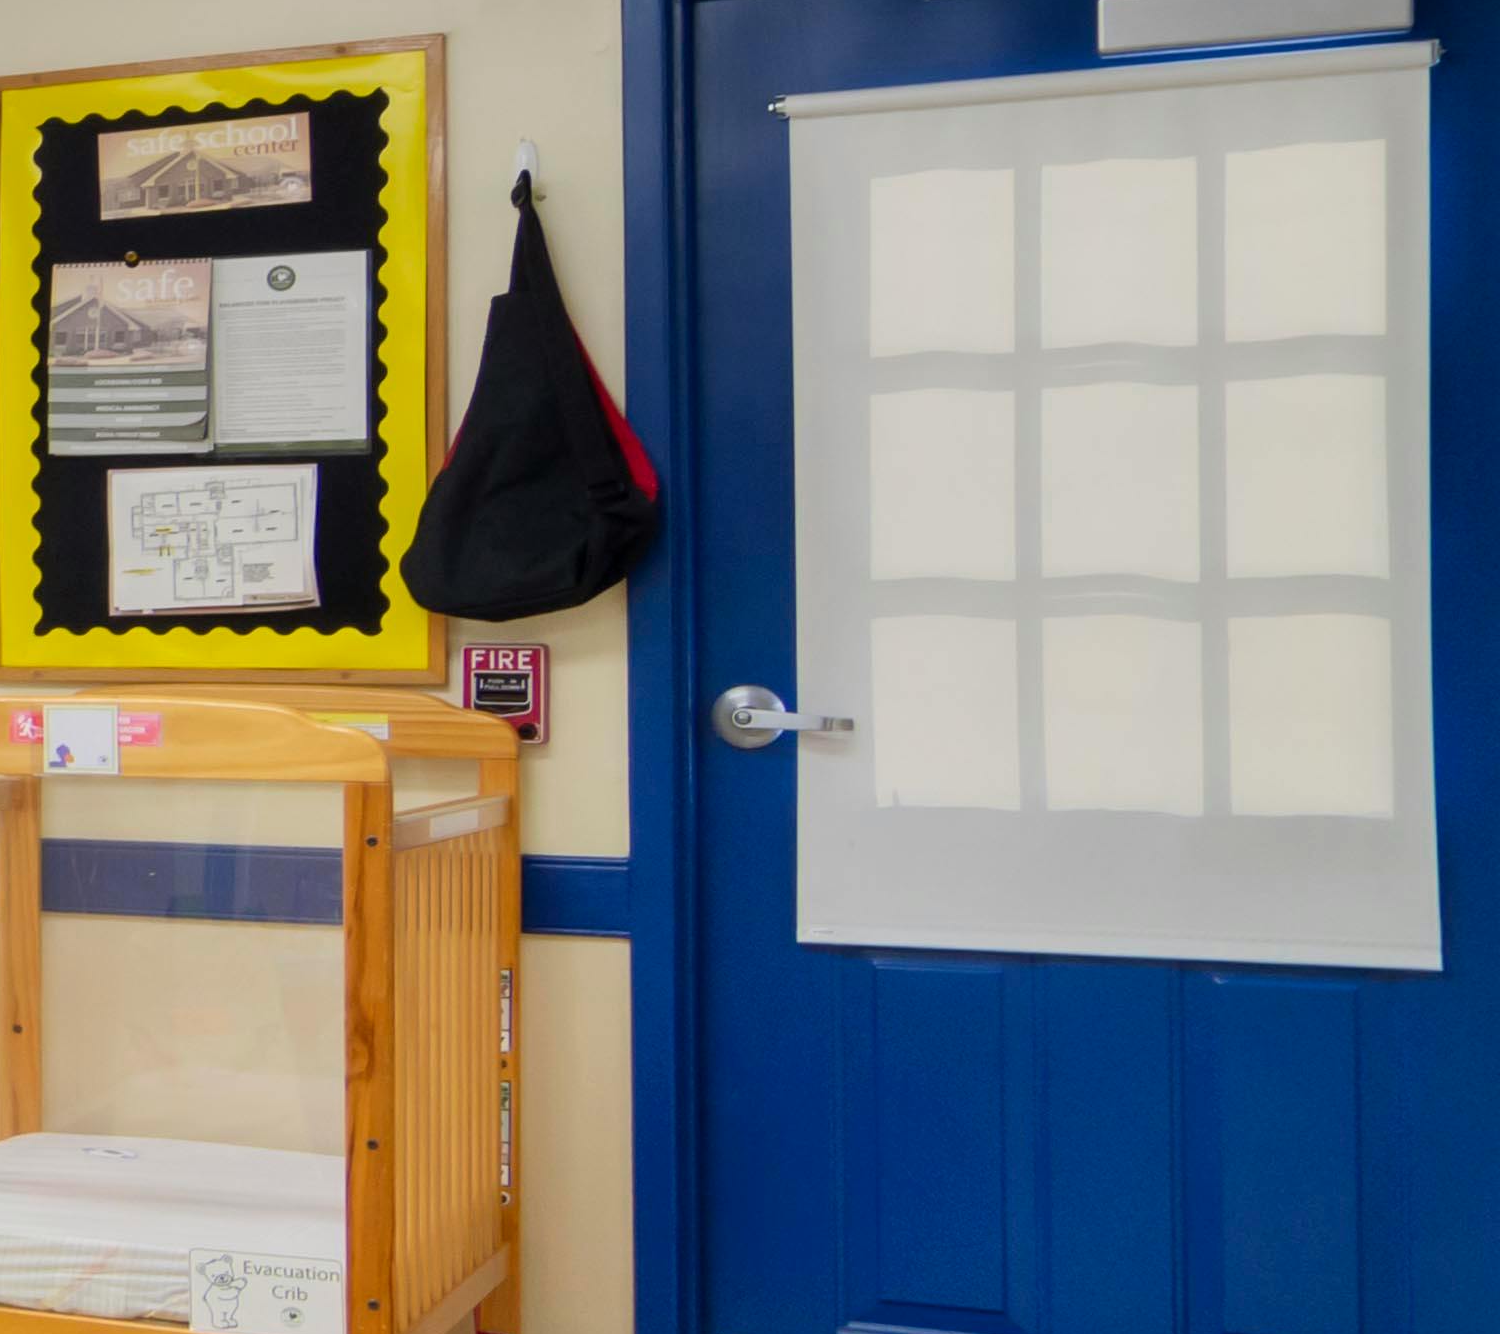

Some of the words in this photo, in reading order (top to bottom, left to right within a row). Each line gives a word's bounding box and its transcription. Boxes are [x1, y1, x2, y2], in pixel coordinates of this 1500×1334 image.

[126, 128, 187, 157] safe
[193, 116, 299, 149] school
[233, 137, 299, 157] center
[116, 269, 194, 301] safe
[471, 649, 533, 670] FIRE
[243, 1260, 341, 1283] Evacuation
[271, 1285, 309, 1302] Crib
